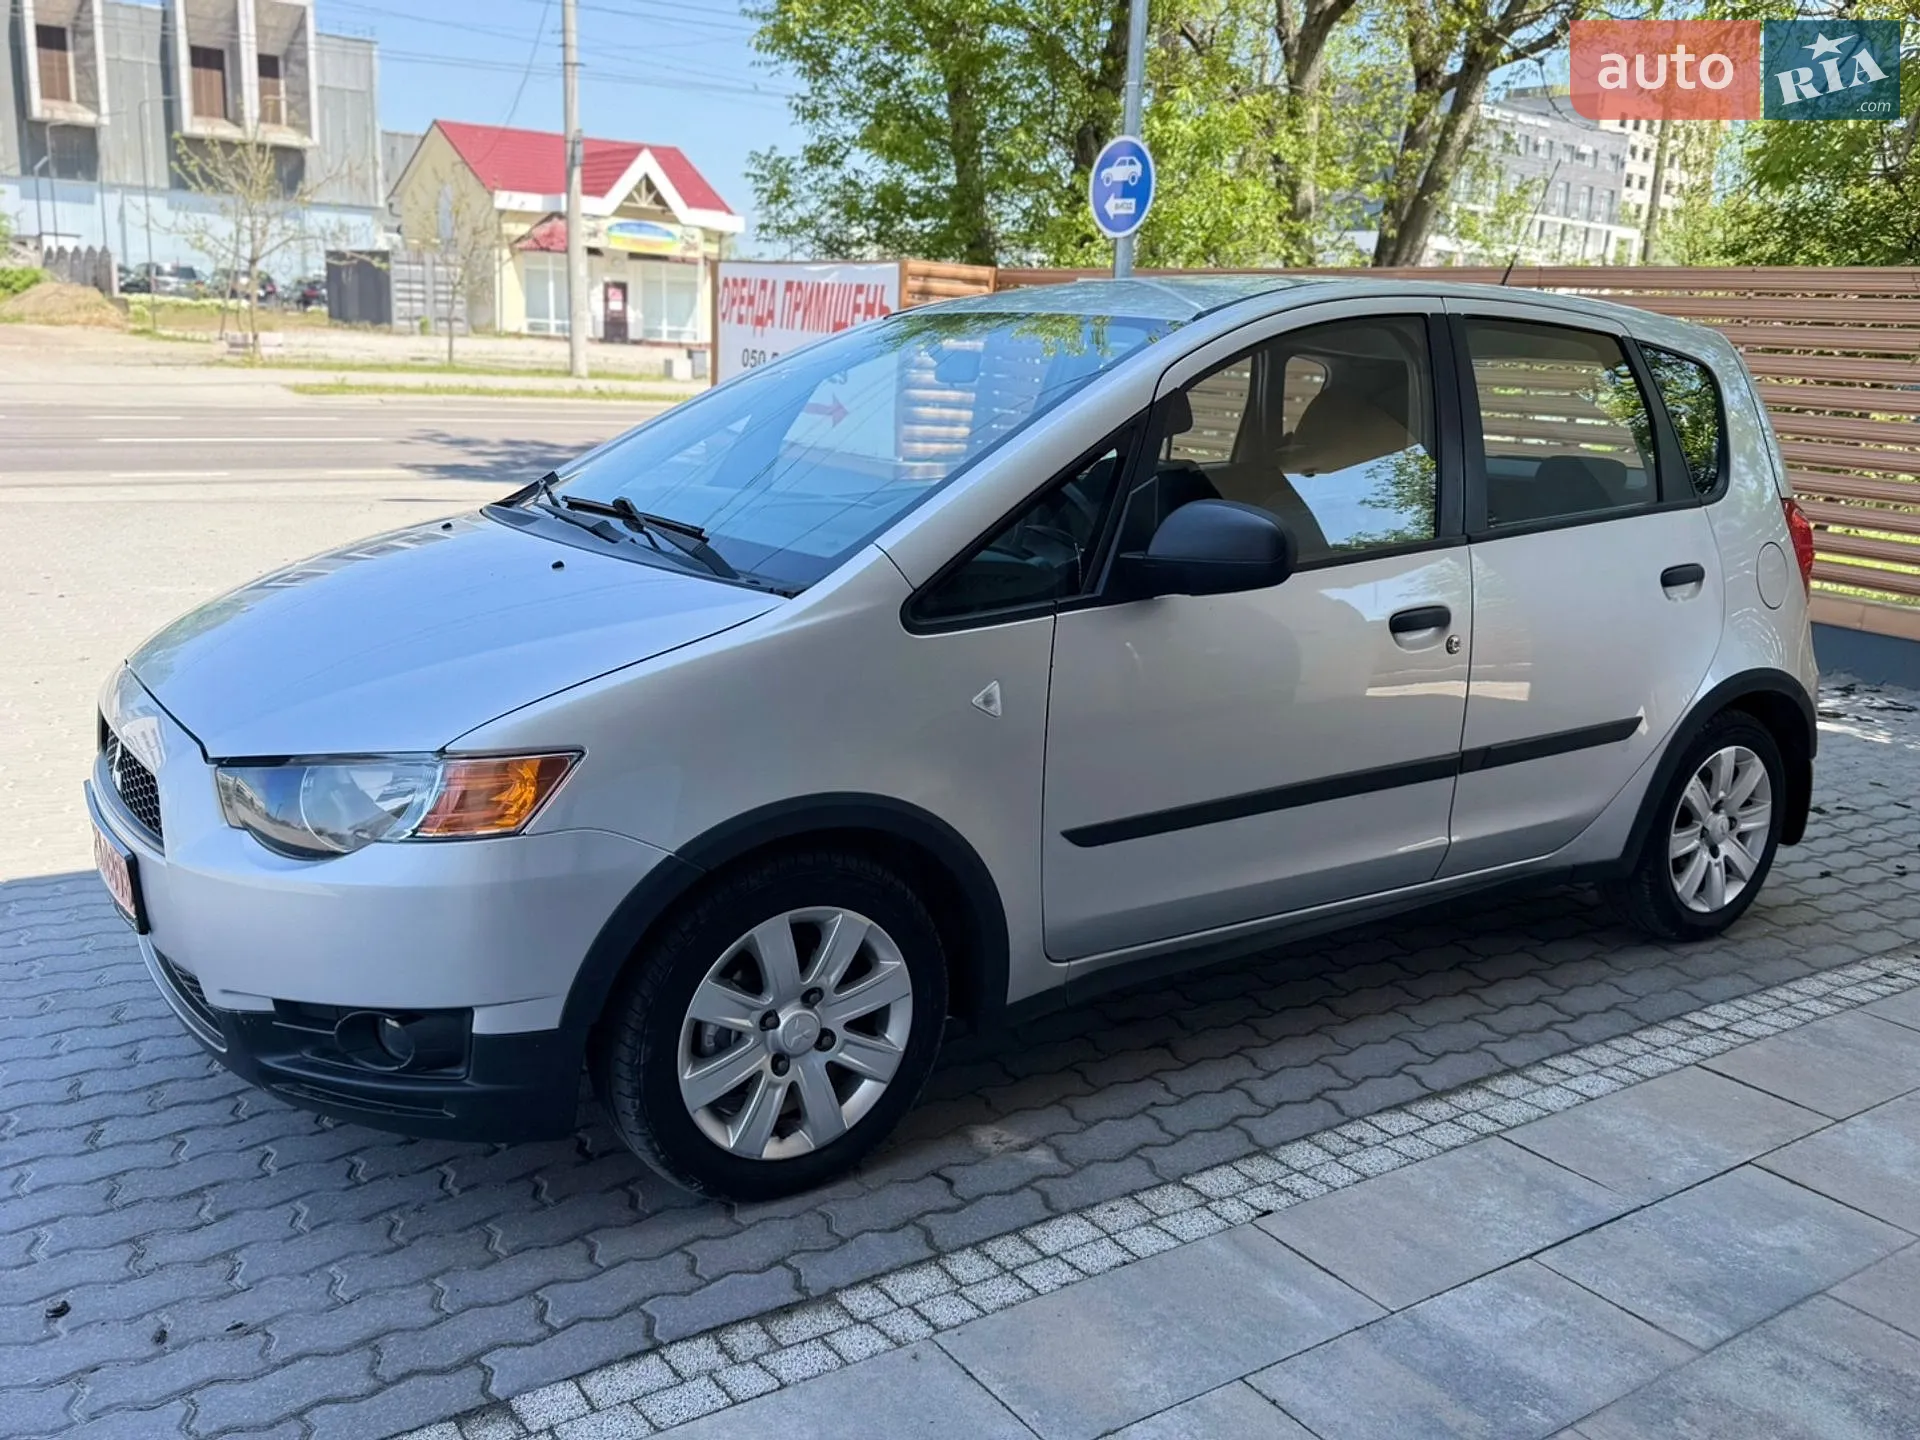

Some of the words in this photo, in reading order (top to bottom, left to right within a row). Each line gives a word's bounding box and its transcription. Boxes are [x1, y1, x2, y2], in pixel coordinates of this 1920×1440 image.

[719, 277, 777, 337] ОРЕНДА
[779, 280, 892, 333] ПРИМІЩЕНЬ
[741, 348, 767, 368] 050
